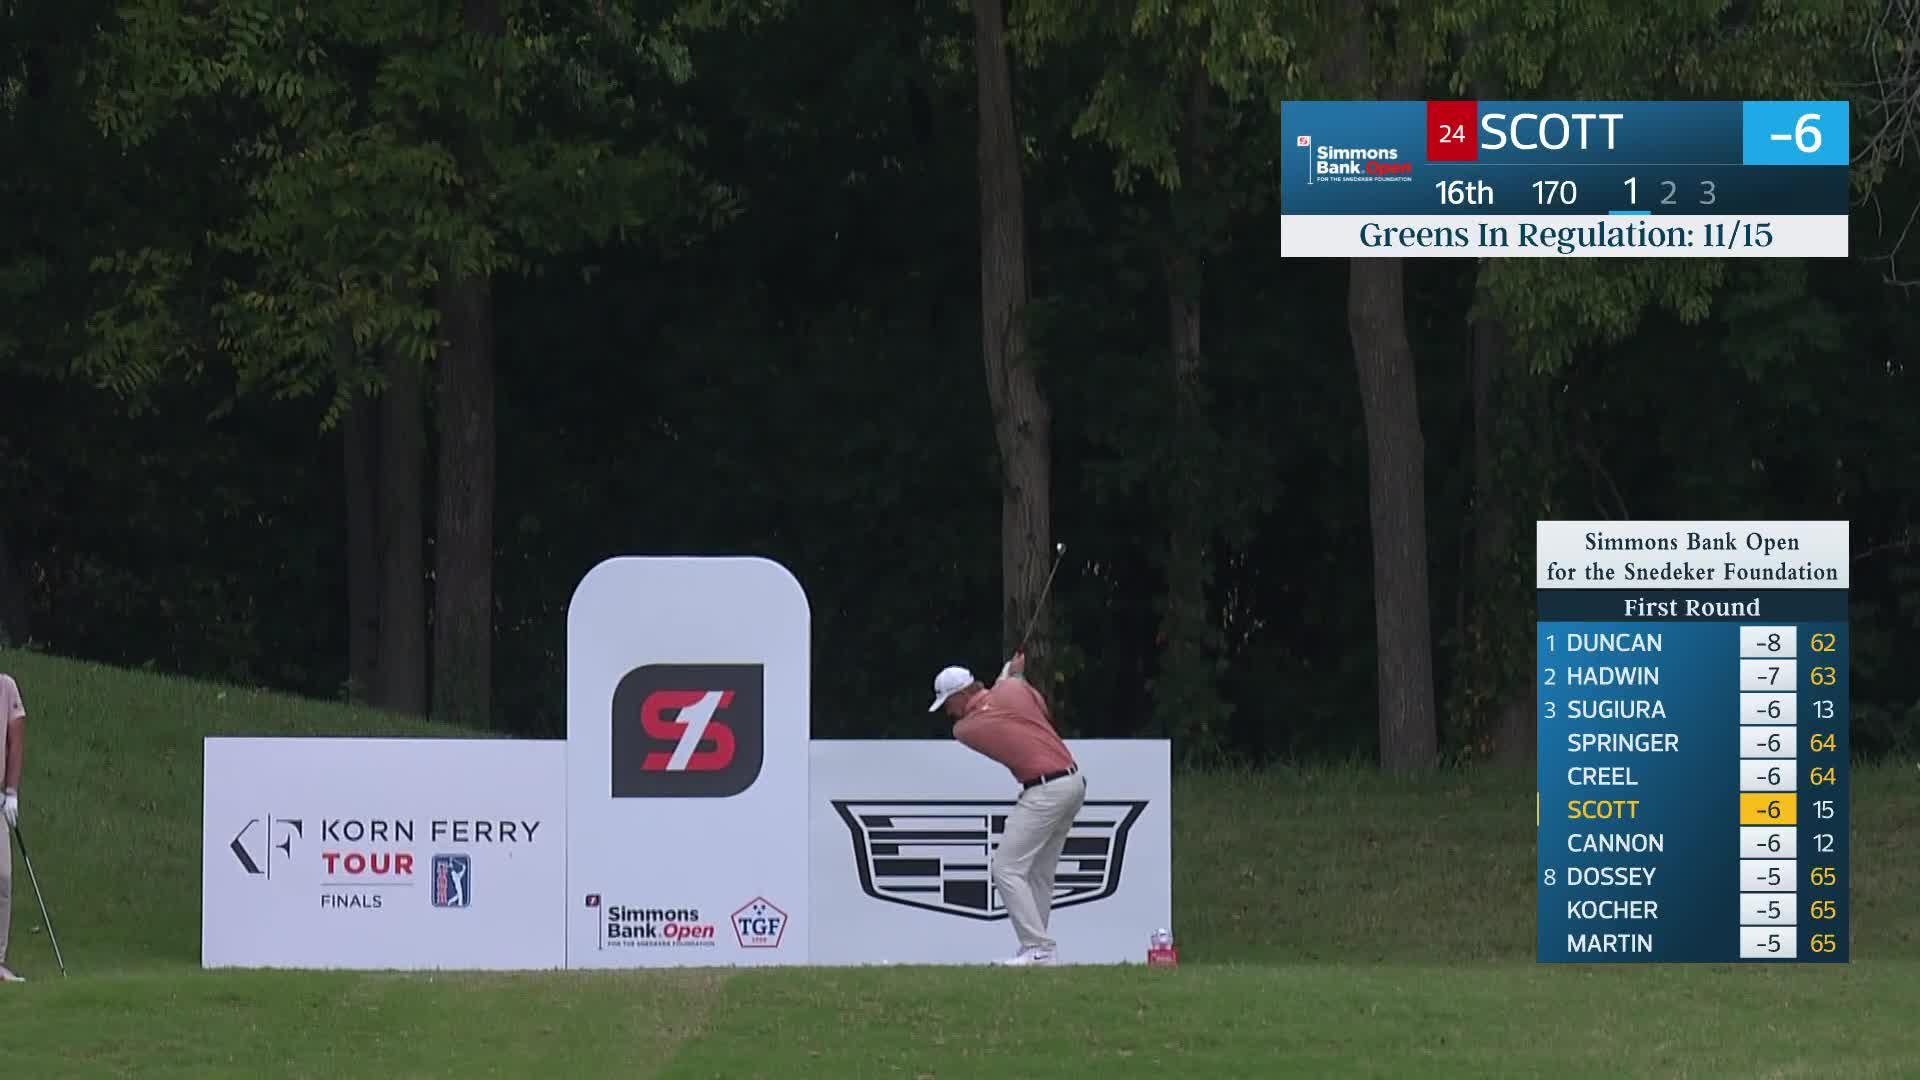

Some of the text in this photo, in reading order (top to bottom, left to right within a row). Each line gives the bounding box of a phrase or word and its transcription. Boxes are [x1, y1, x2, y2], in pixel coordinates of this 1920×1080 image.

[321, 819, 414, 843] KORN
[431, 819, 540, 843] FERRY
[322, 852, 414, 875] TOUR
[320, 894, 383, 909] FINALS
[607, 905, 699, 922] Simmons
[738, 917, 780, 936] TGF
